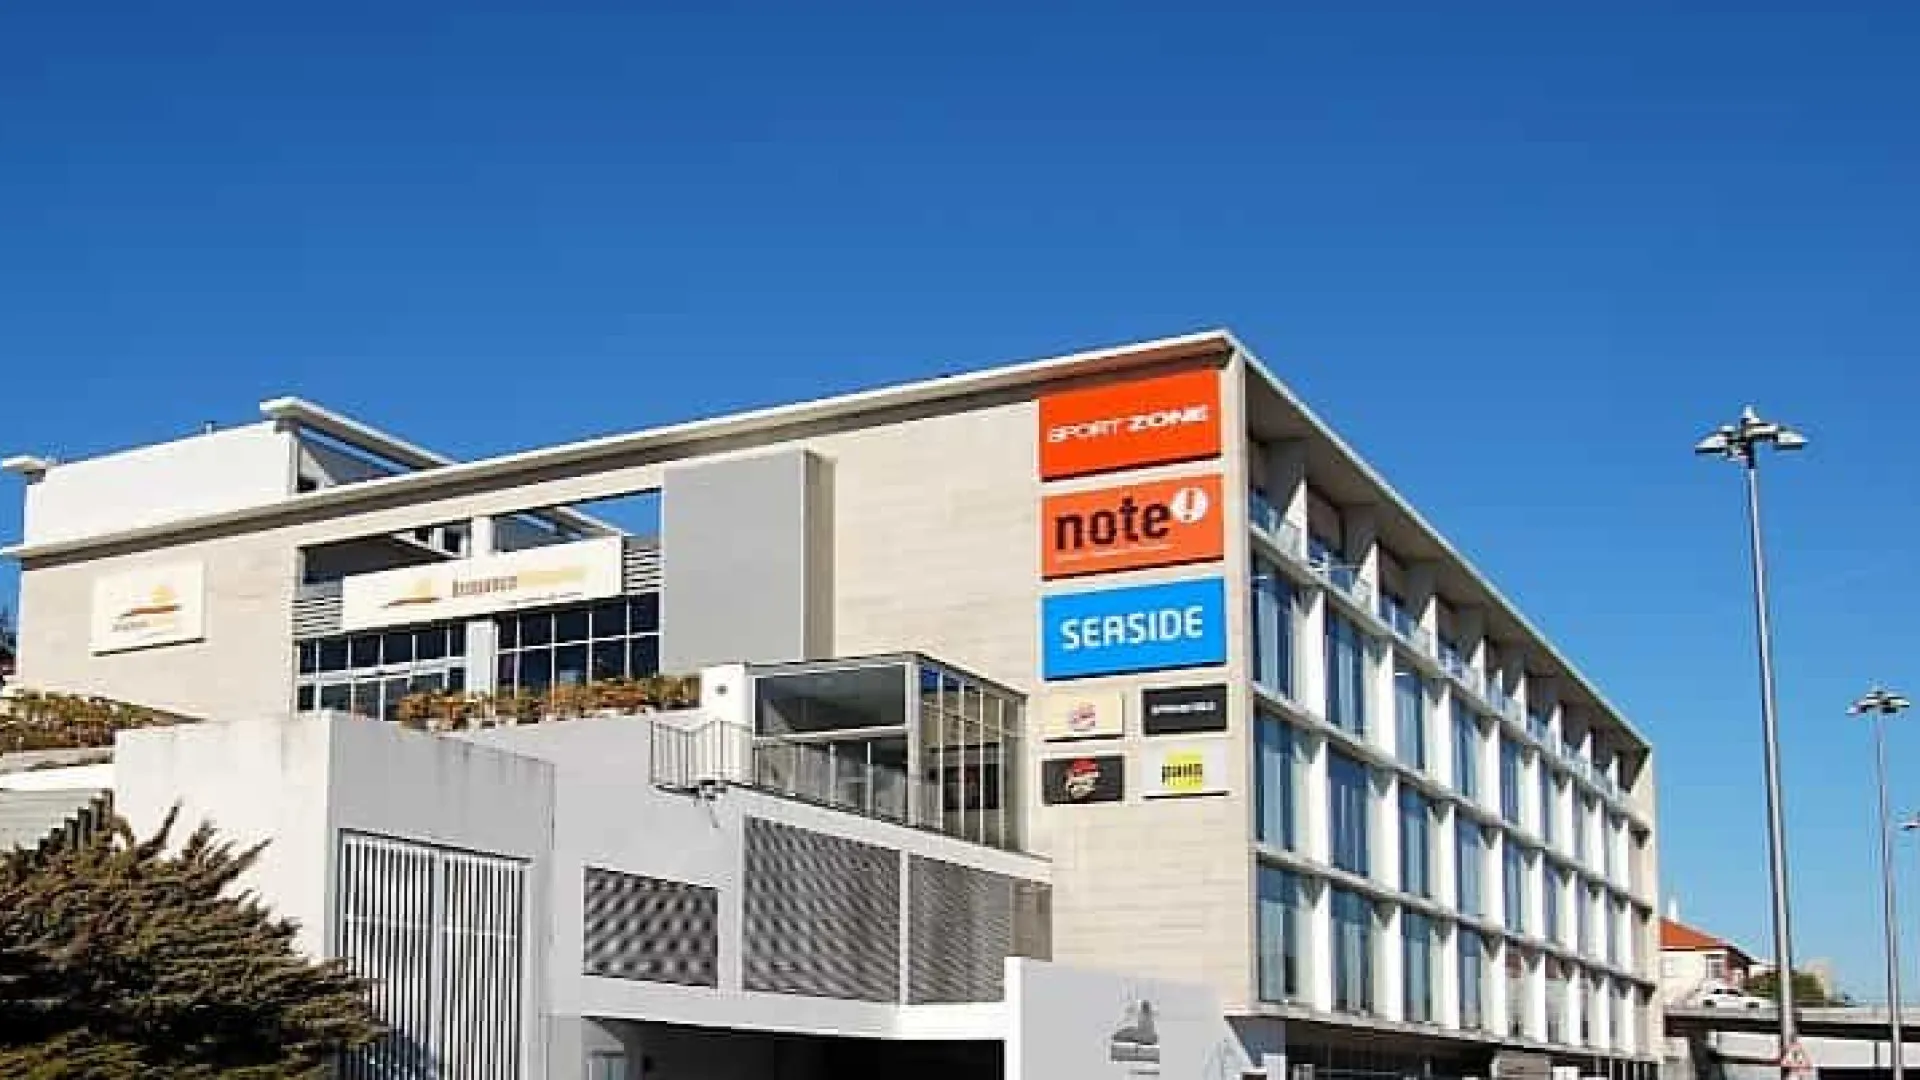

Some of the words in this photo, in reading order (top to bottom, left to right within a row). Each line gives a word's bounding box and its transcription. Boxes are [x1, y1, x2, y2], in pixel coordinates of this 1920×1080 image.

[1048, 420, 1117, 442] SPORT
[1127, 405, 1208, 431] ZONE
[1061, 606, 1203, 650] SEASIDE
